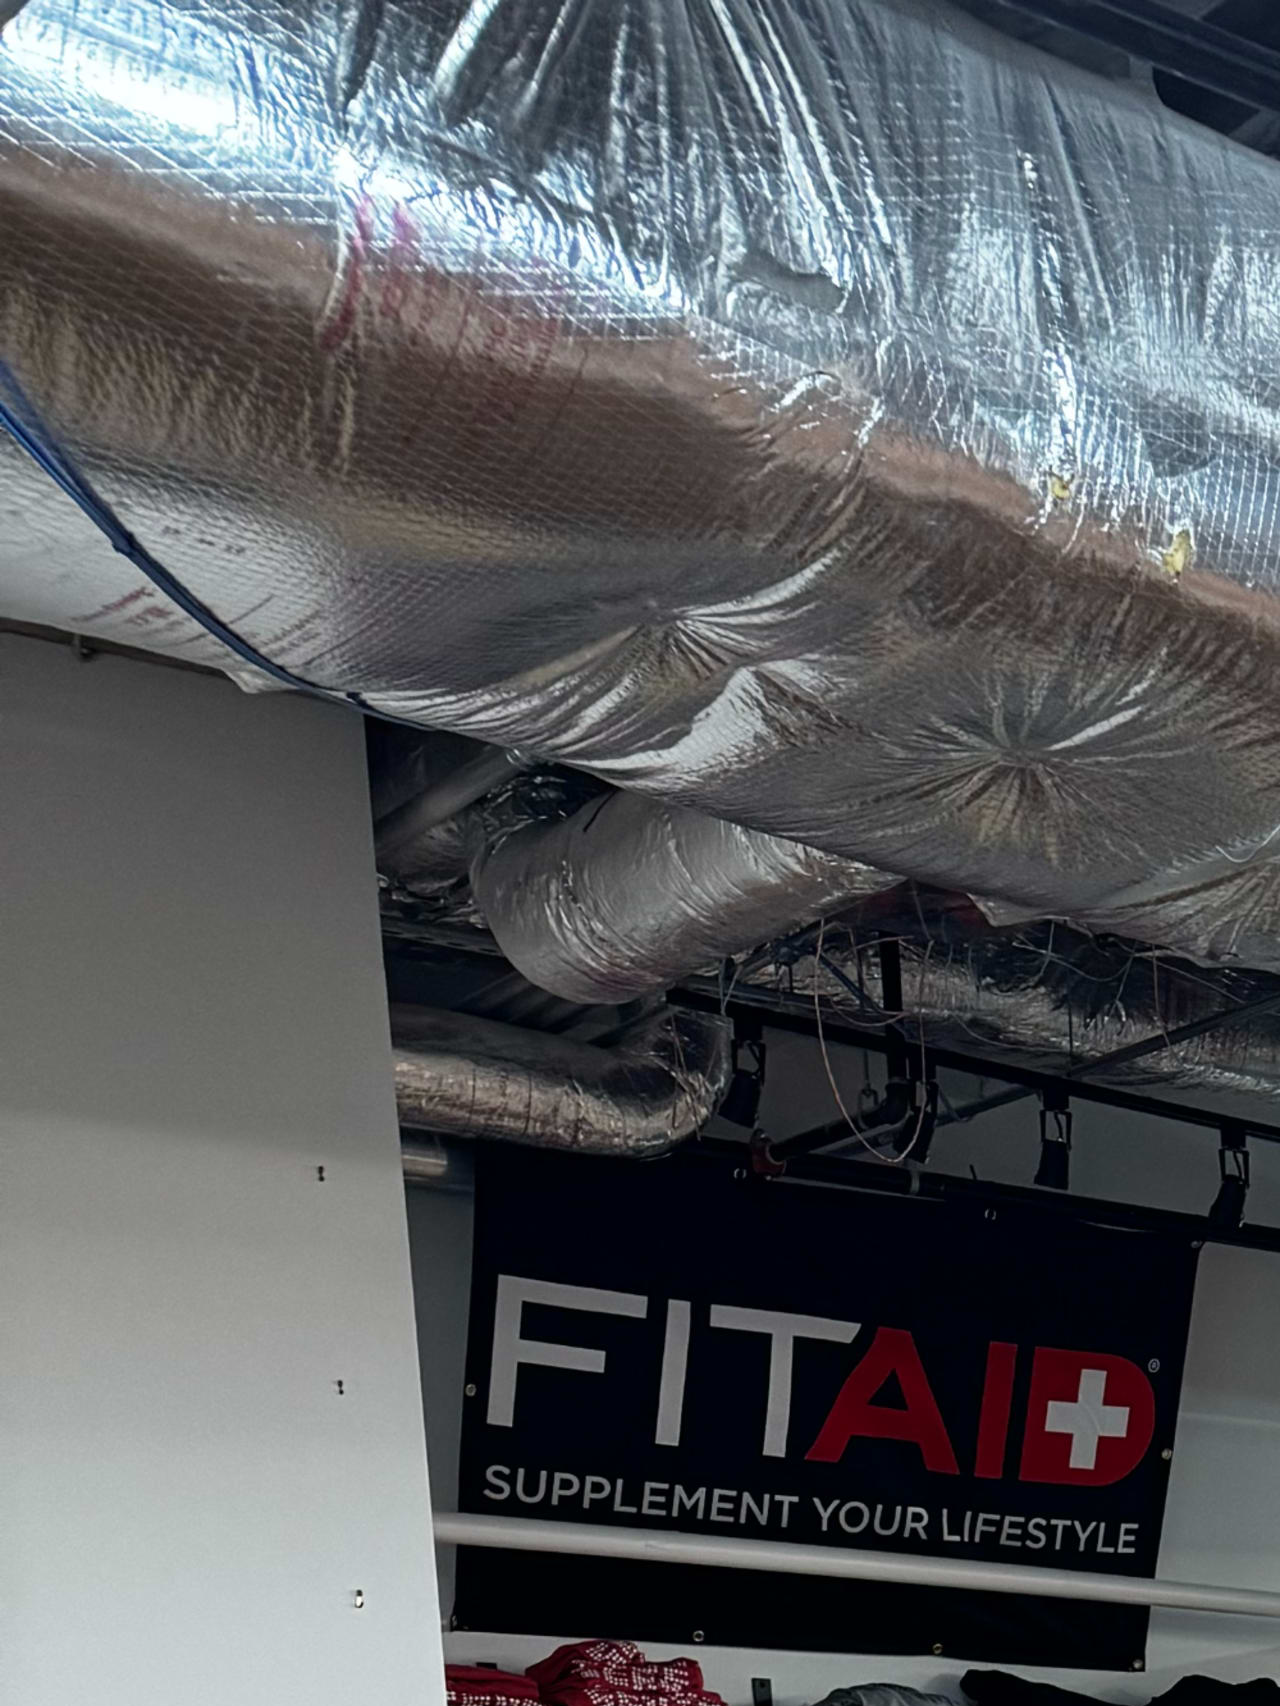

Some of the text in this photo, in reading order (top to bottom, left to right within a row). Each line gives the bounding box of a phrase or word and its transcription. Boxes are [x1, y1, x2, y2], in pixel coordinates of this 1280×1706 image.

[485, 1273, 1156, 1488] FITAID
[483, 1464, 1139, 1555] SUPPLEMENT YOUR LIFESTYLE
